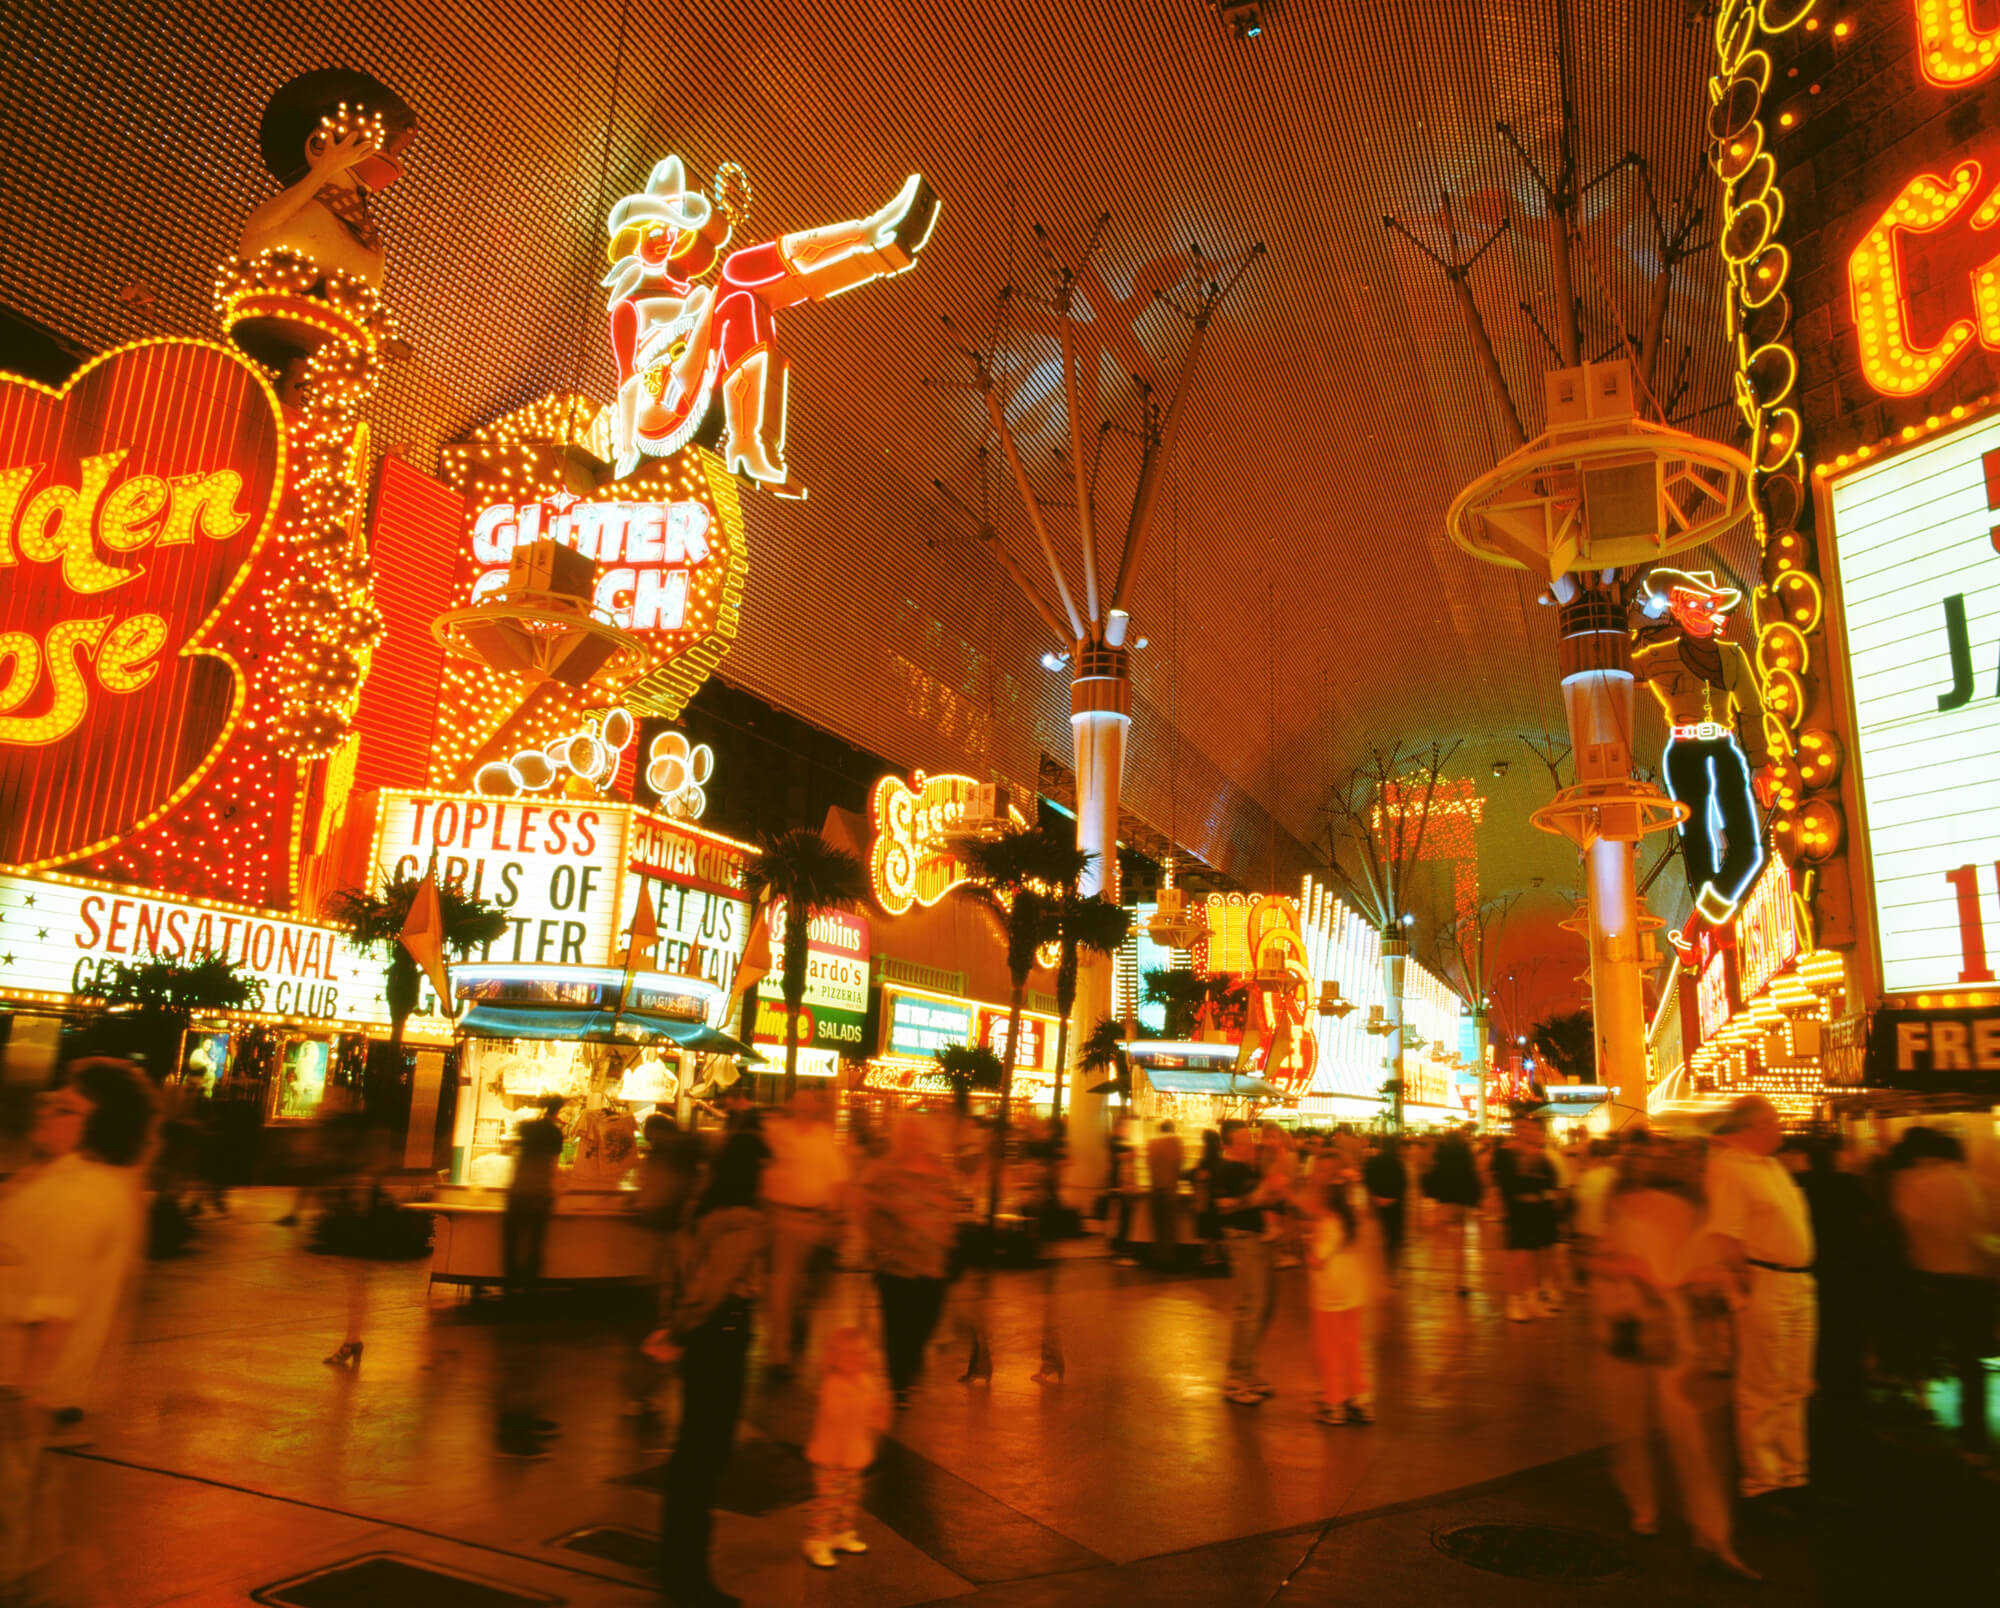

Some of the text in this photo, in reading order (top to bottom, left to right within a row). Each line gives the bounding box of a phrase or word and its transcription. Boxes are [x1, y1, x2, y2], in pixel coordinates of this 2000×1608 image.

[409, 797, 600, 857] TOPLESS
[549, 864, 603, 913] OF
[74, 895, 340, 982] SENSATIONAL
[702, 892, 735, 943] US
[808, 910, 861, 952] obbins
[809, 958, 862, 987] ardo's
[275, 979, 340, 1019] CLUB
[821, 985, 862, 1004] PIZZERIA
[755, 1000, 809, 1044] limpe
[818, 1020, 863, 1043] SALADS
